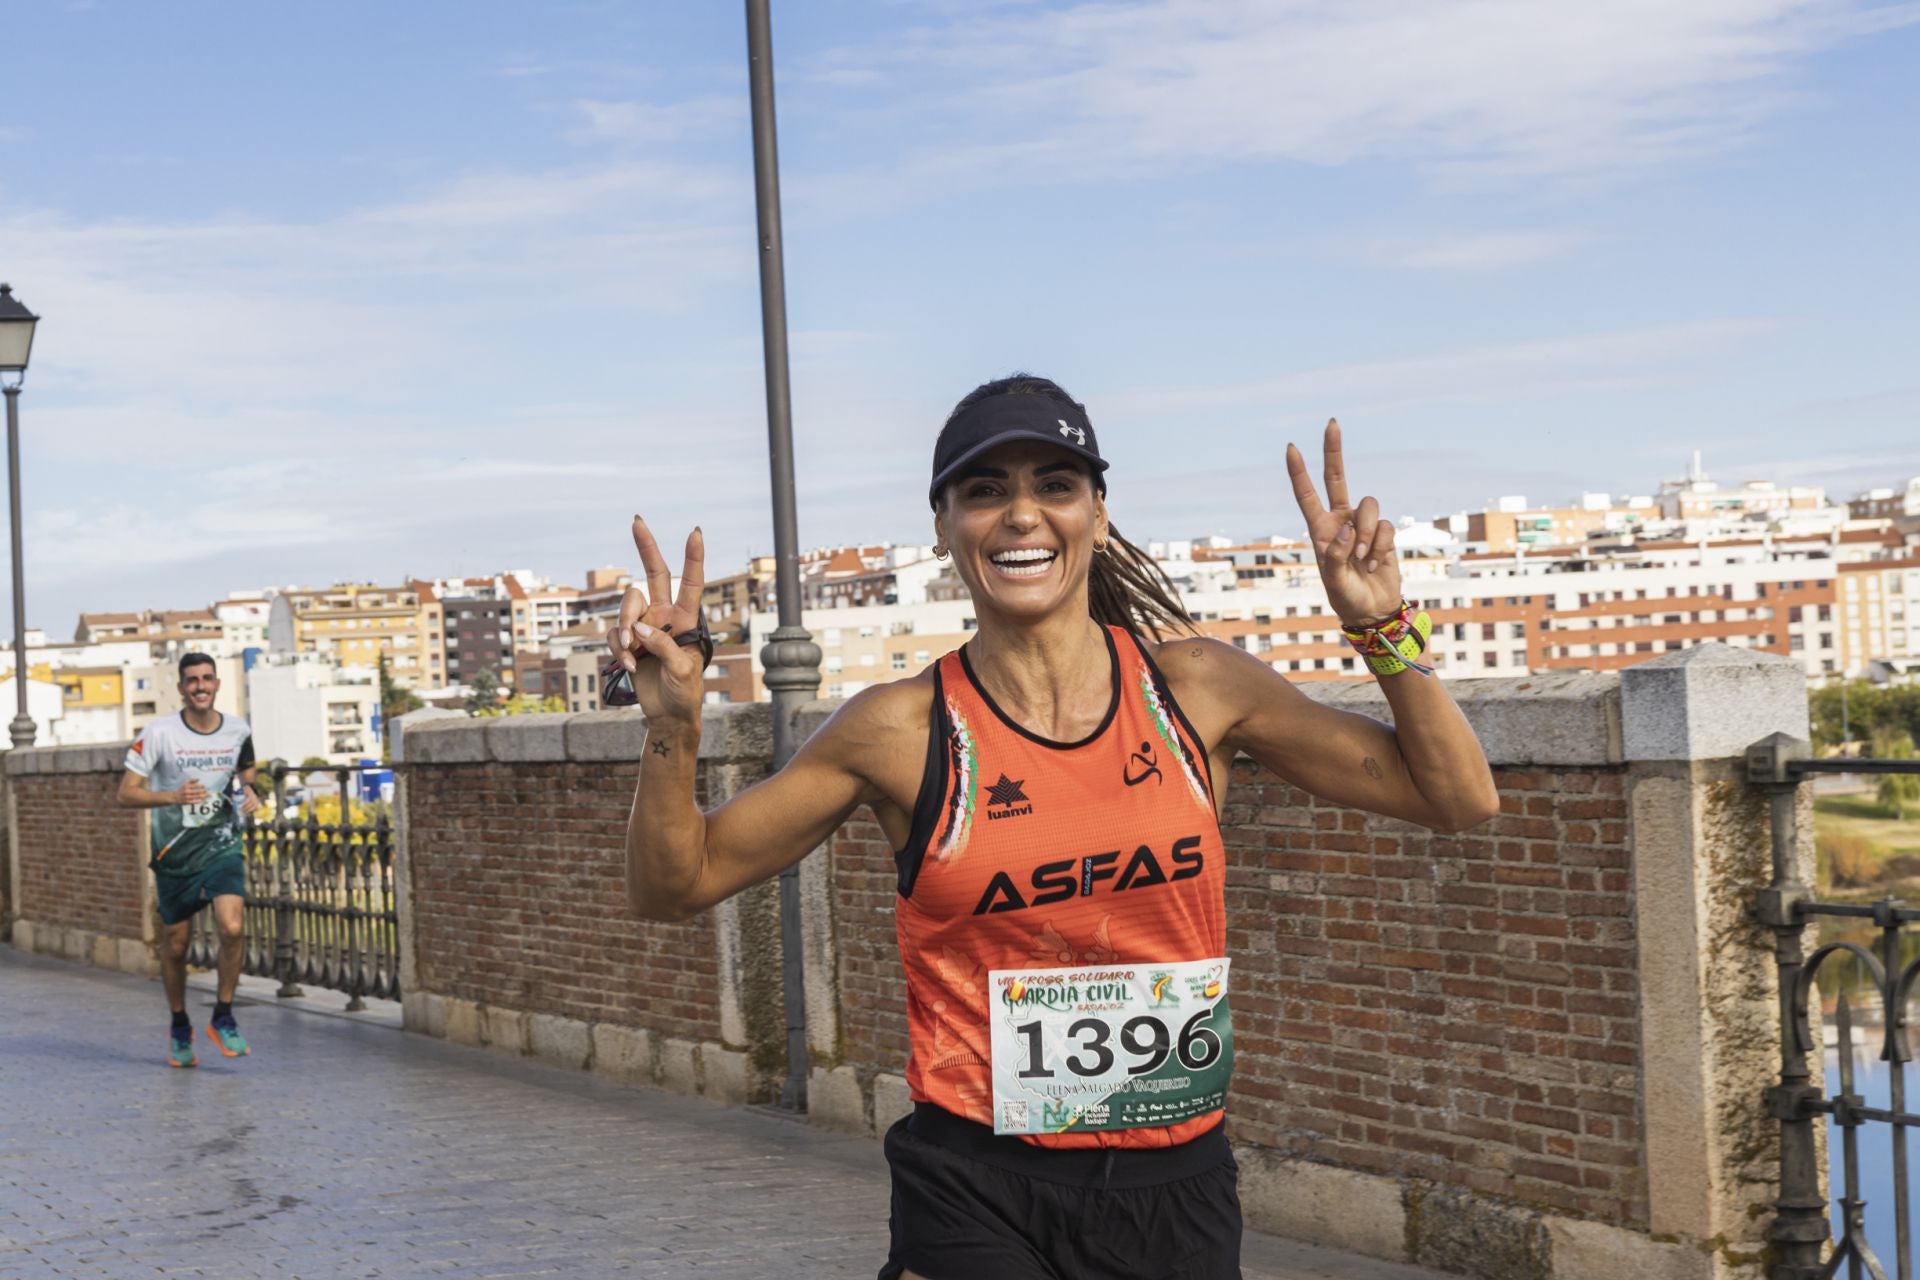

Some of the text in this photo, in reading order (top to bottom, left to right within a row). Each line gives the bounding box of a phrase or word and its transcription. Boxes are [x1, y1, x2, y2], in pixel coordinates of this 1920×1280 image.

[987, 804, 1033, 821] luanvi
[972, 835, 1204, 916] ASFAS
[1068, 970, 1135, 984] SOLIDARIO
[1016, 1008, 1222, 1078] 1396
[1046, 1083, 1079, 1095] ELENA
[1084, 1103, 1110, 1113] Plena
